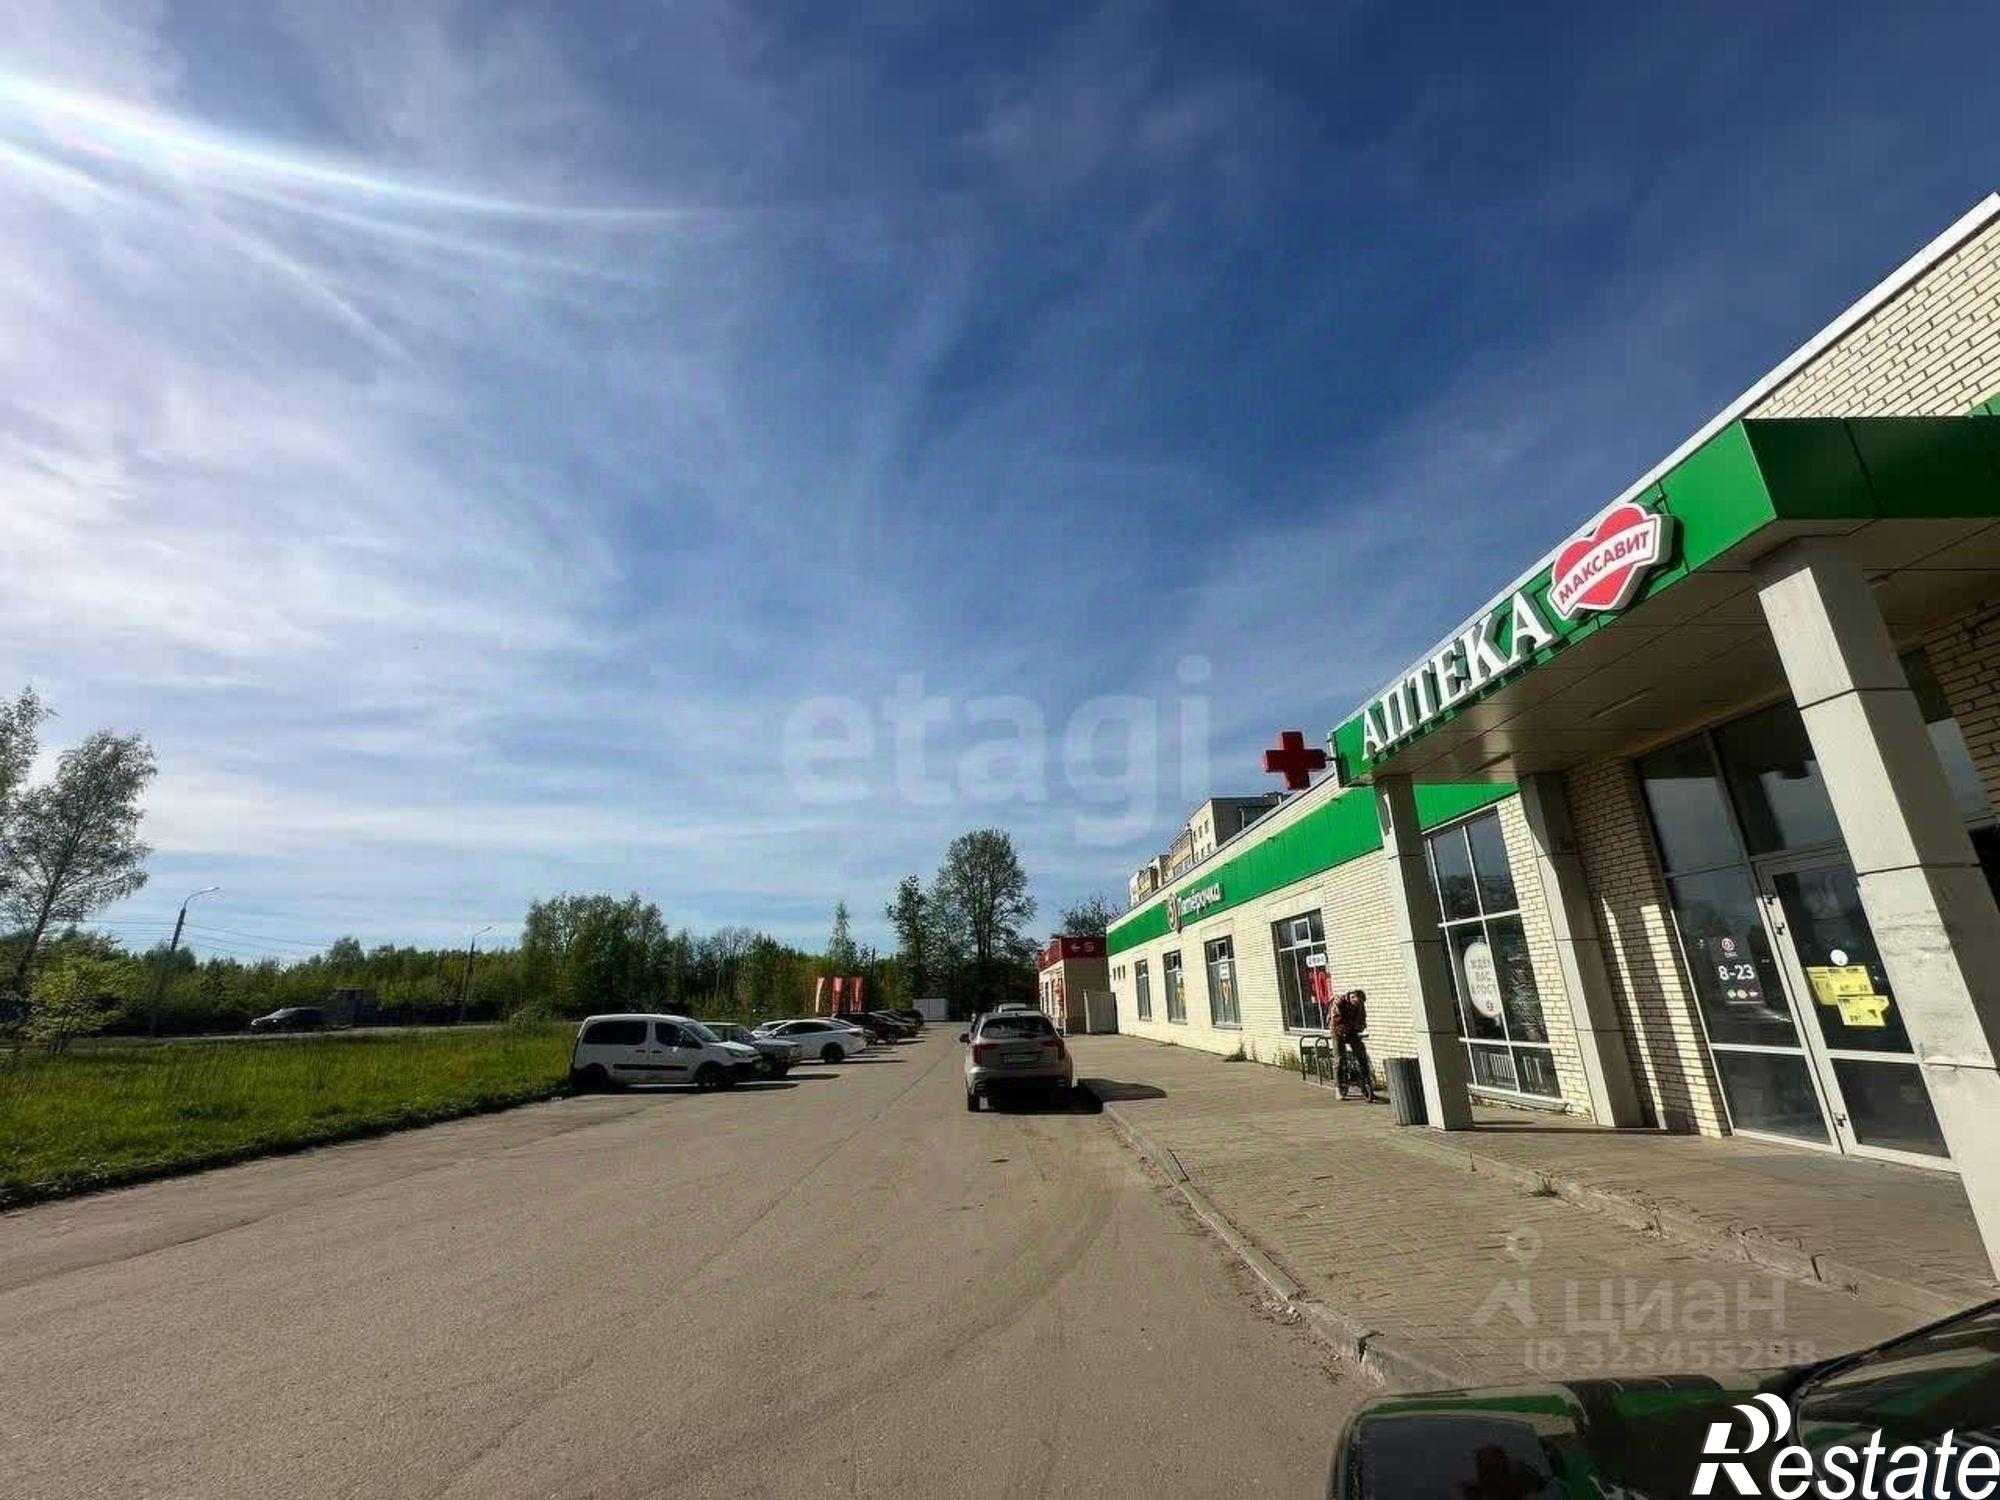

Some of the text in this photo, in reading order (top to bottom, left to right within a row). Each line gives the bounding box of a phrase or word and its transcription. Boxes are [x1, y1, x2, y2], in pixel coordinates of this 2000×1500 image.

[1557, 530, 1650, 605] МАКСАВИТ
[1360, 590, 1553, 762] АПТЕКА
[1718, 963, 1755, 981] 8-23
